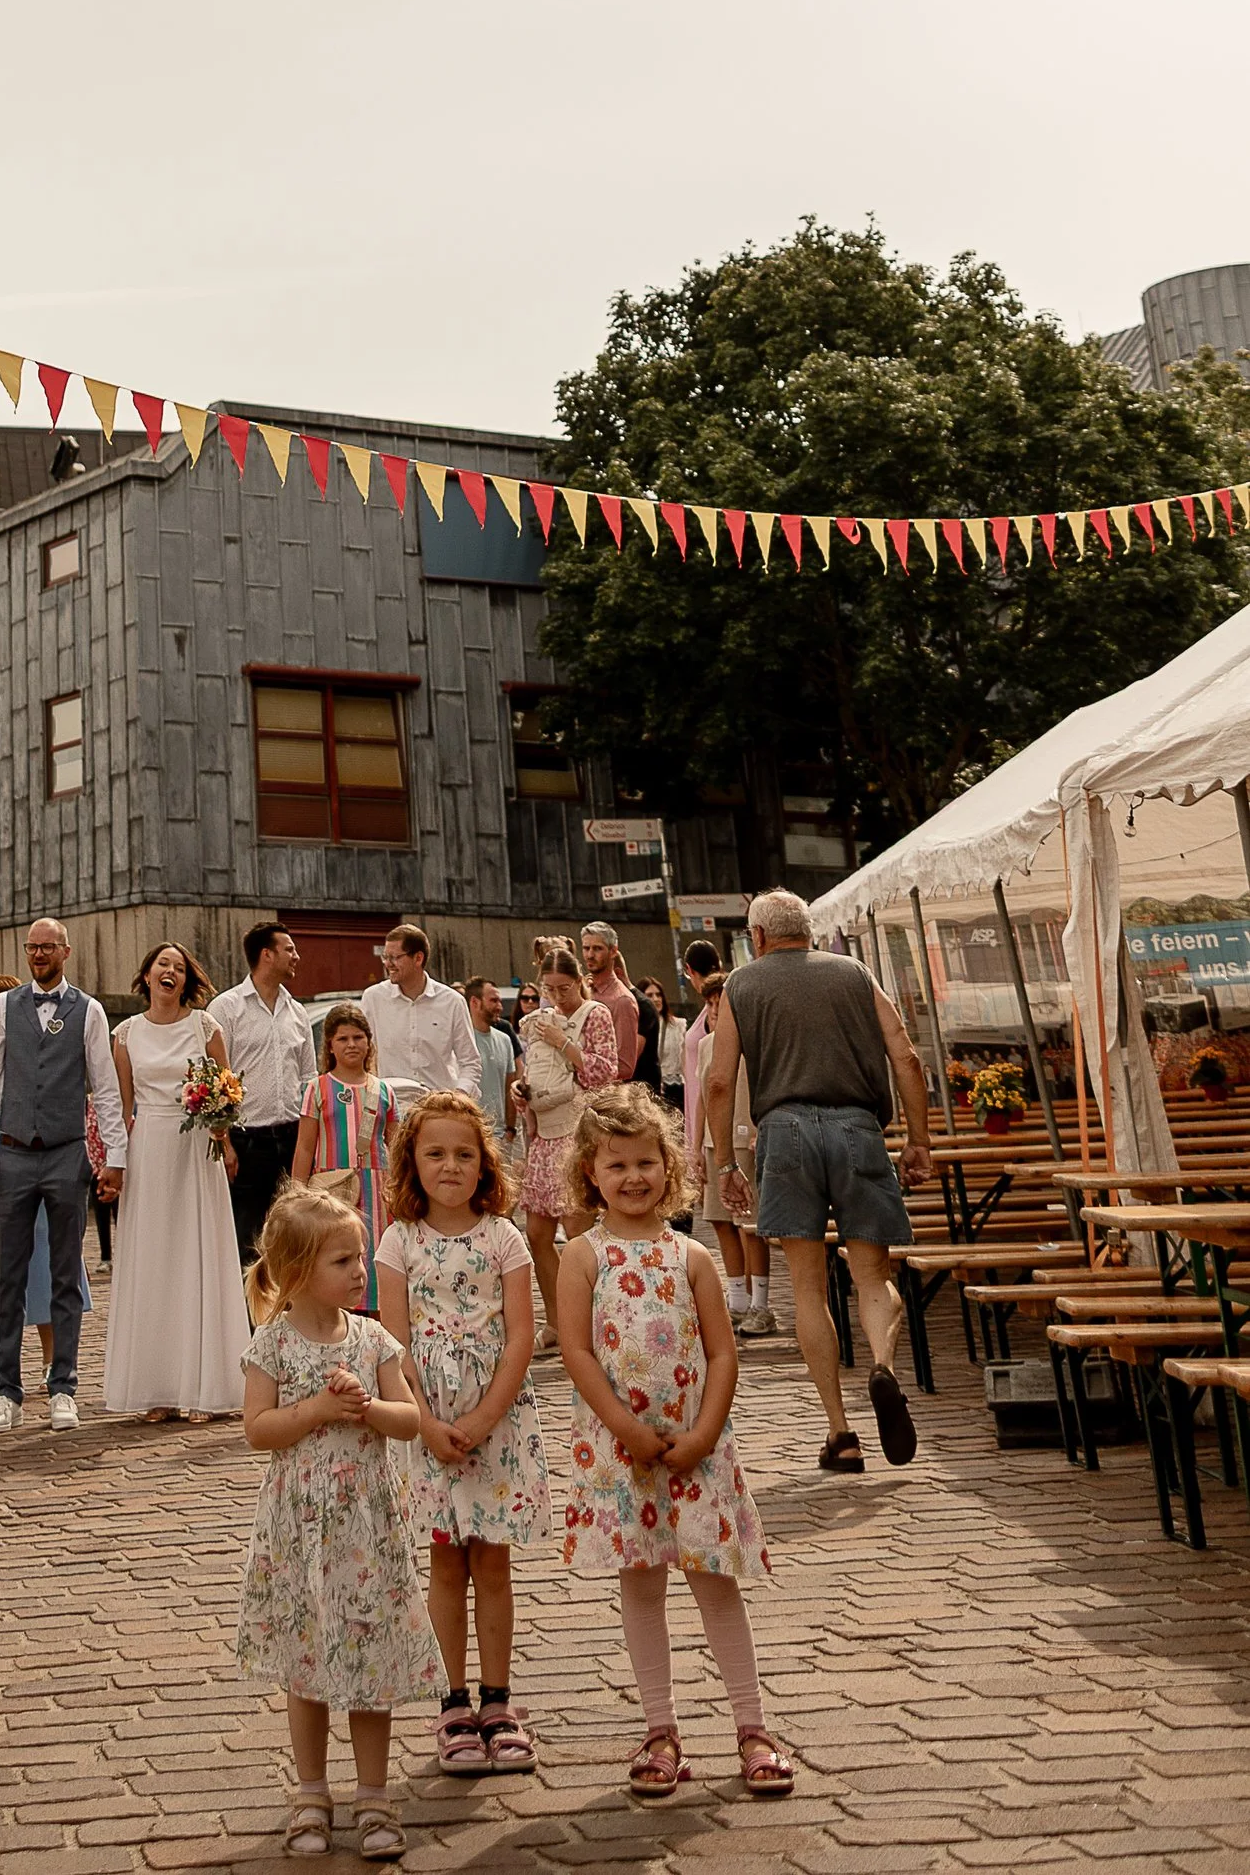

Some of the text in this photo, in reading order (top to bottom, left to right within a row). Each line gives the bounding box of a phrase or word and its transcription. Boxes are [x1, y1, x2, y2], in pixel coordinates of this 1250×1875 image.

[970, 928, 996, 942] ASP
[1150, 932, 1219, 952] feiern
[1198, 961, 1241, 978] uns
